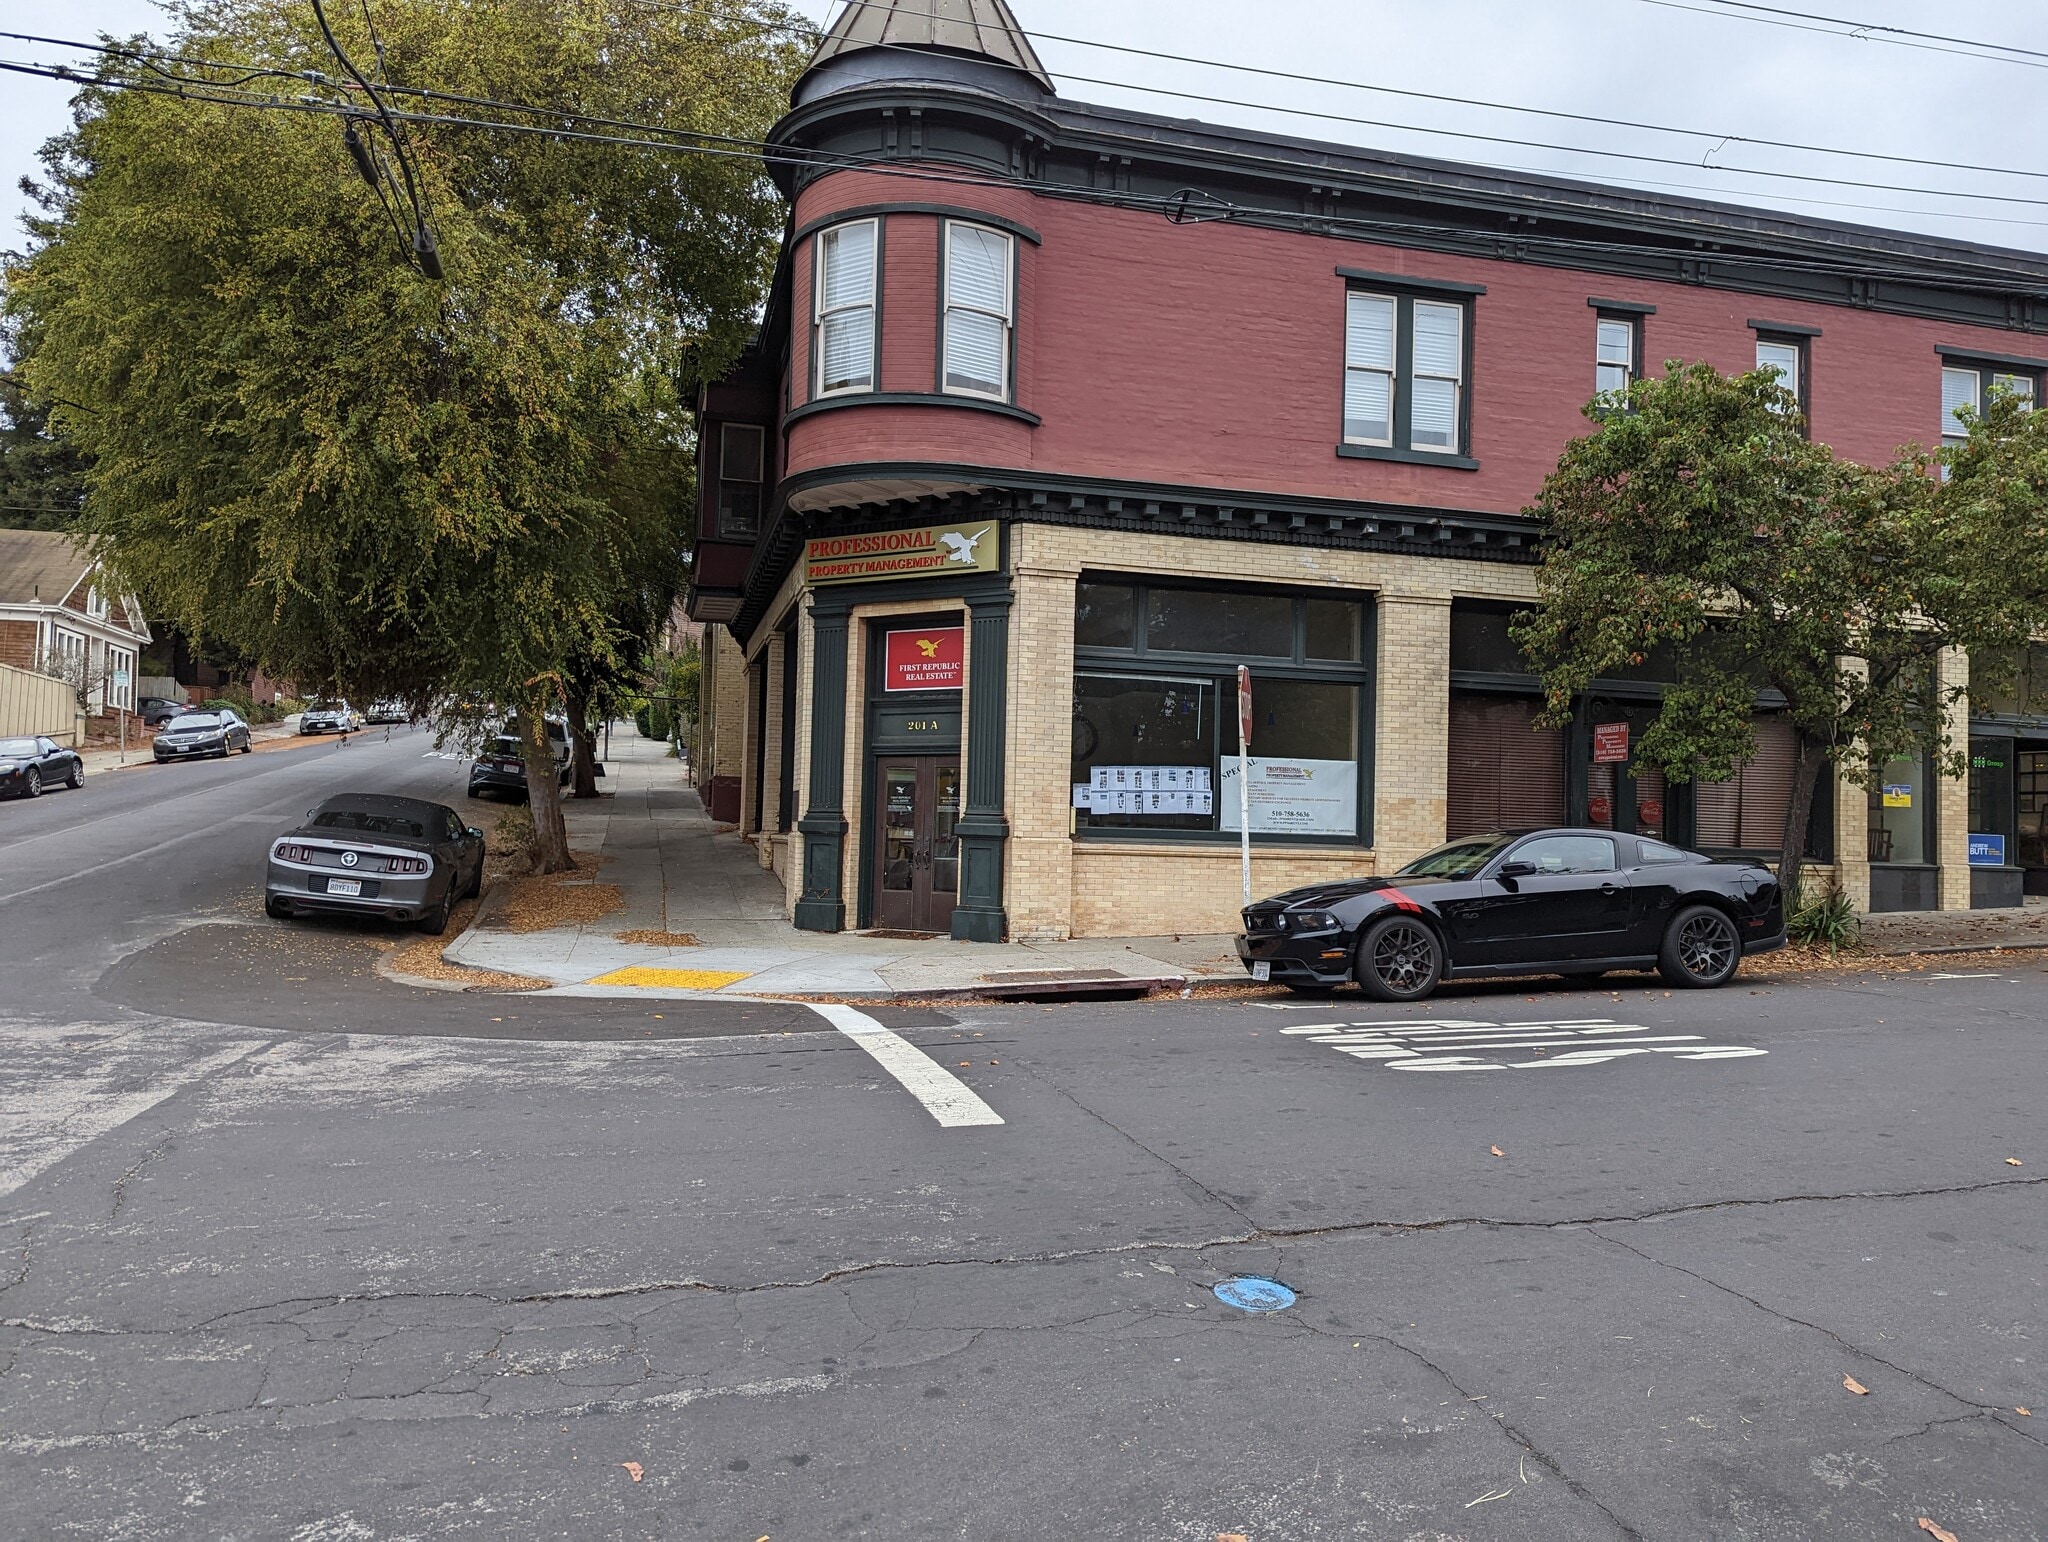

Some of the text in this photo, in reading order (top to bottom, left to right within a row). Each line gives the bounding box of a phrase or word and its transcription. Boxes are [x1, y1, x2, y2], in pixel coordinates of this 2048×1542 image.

[809, 530, 936, 558] PROFESSIONAL
[809, 554, 947, 577] PROPERTY MANAGEMENT
[899, 662, 961, 671] FIRST REPUBLIC
[926, 672, 953, 680] ESTATE
[908, 720, 938, 730] 201 A
[1986, 760, 2005, 768] Group
[1222, 758, 1258, 781] SPECAL
[1969, 847, 1988, 855] BUTT
